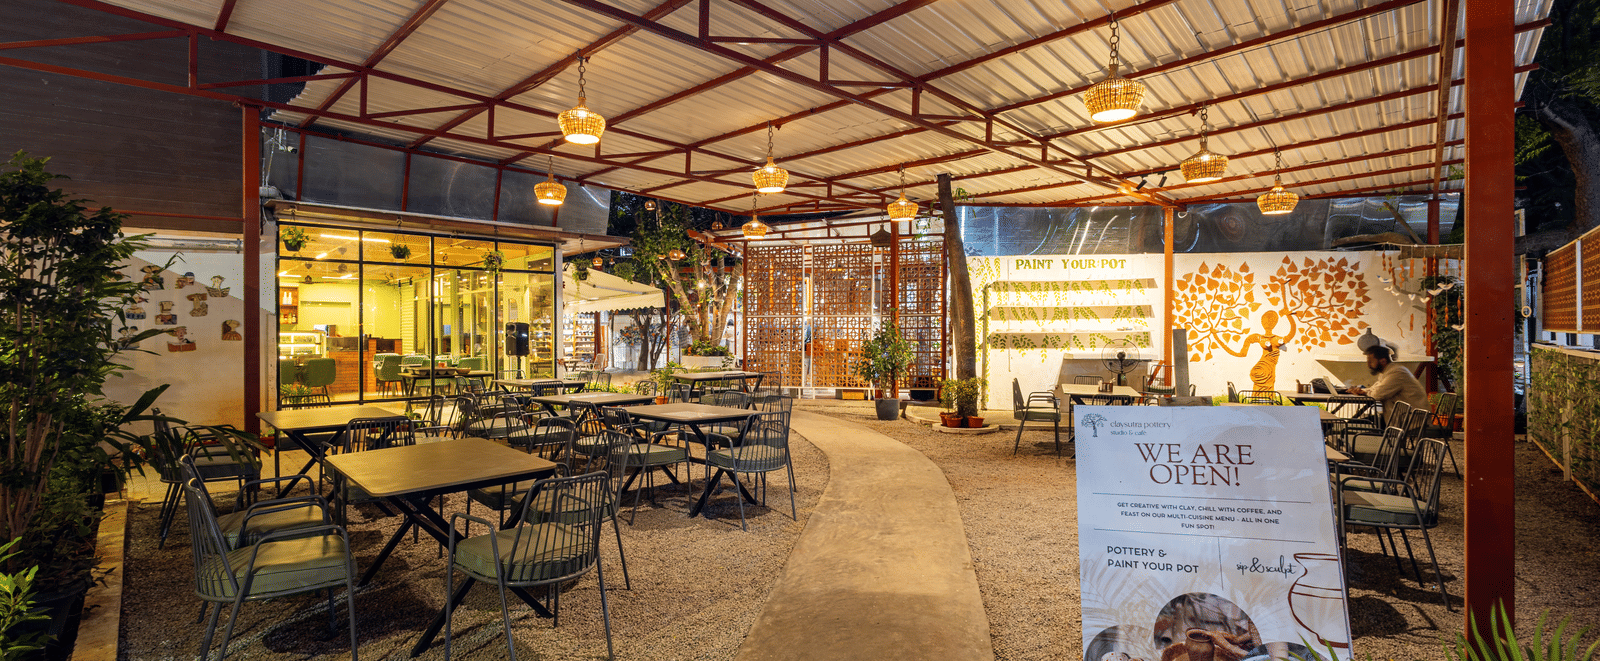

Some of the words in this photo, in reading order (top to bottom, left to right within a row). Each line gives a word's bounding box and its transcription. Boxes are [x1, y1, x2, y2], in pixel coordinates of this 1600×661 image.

[1015, 258, 1054, 271] PAINT
[1061, 258, 1097, 270] YOUR
[1101, 258, 1127, 269] POT
[1109, 420, 1143, 429] claysutra
[1143, 421, 1172, 430] pottery
[1134, 442, 1184, 464] WE
[1190, 443, 1255, 466] ARE
[1149, 463, 1241, 487] OPEN!
[1130, 502, 1160, 510] CREATIVE
[1179, 504, 1197, 512] CLAY,
[1236, 507, 1266, 515] COFFEE,
[1166, 513, 1214, 521] MULTI-CUISINE
[1263, 517, 1280, 525] ONE
[1107, 545, 1155, 557] POTTERY
[1158, 548, 1167, 558] &
[1107, 558, 1139, 569] PAINT
[1142, 561, 1173, 572] YOUR
[1176, 563, 1199, 574] POT
